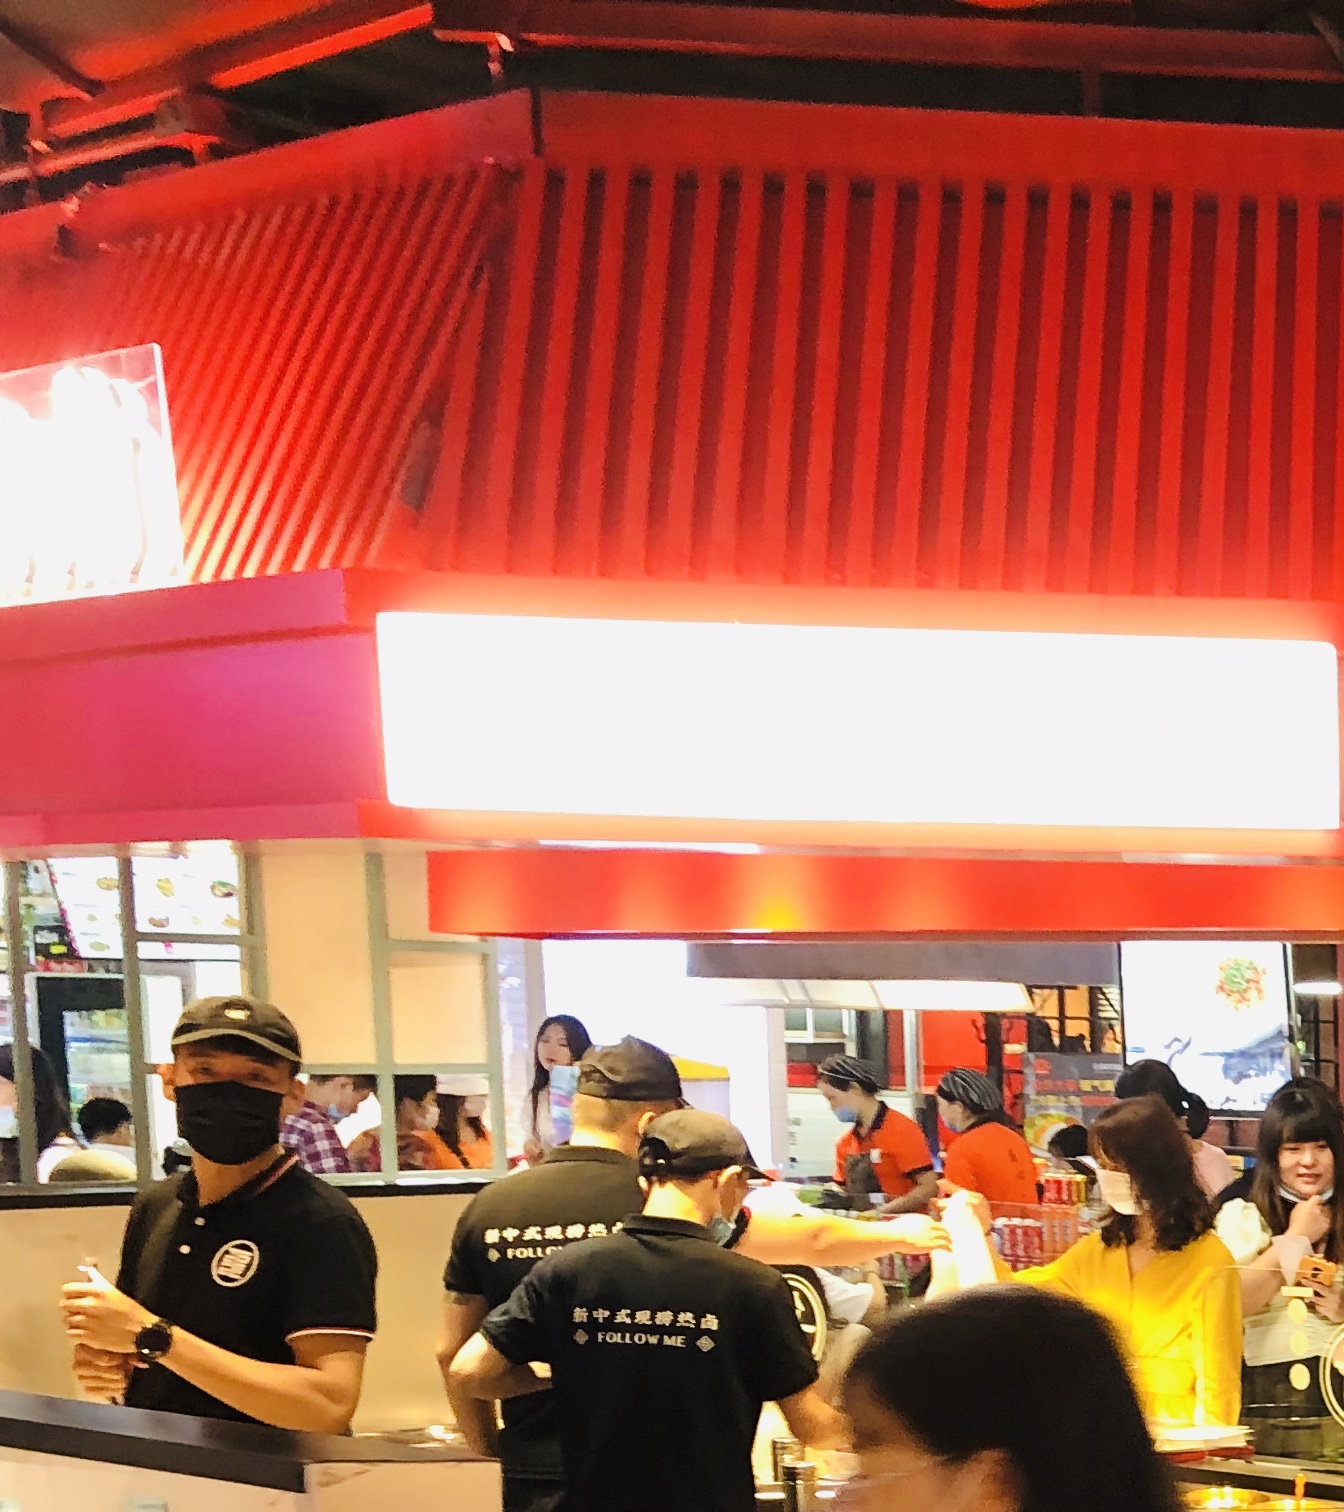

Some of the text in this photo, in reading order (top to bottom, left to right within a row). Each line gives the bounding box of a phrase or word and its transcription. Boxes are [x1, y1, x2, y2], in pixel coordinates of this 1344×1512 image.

[506, 1246, 563, 1260] FOLL
[597, 1331, 687, 1348] FOLLOW ME
